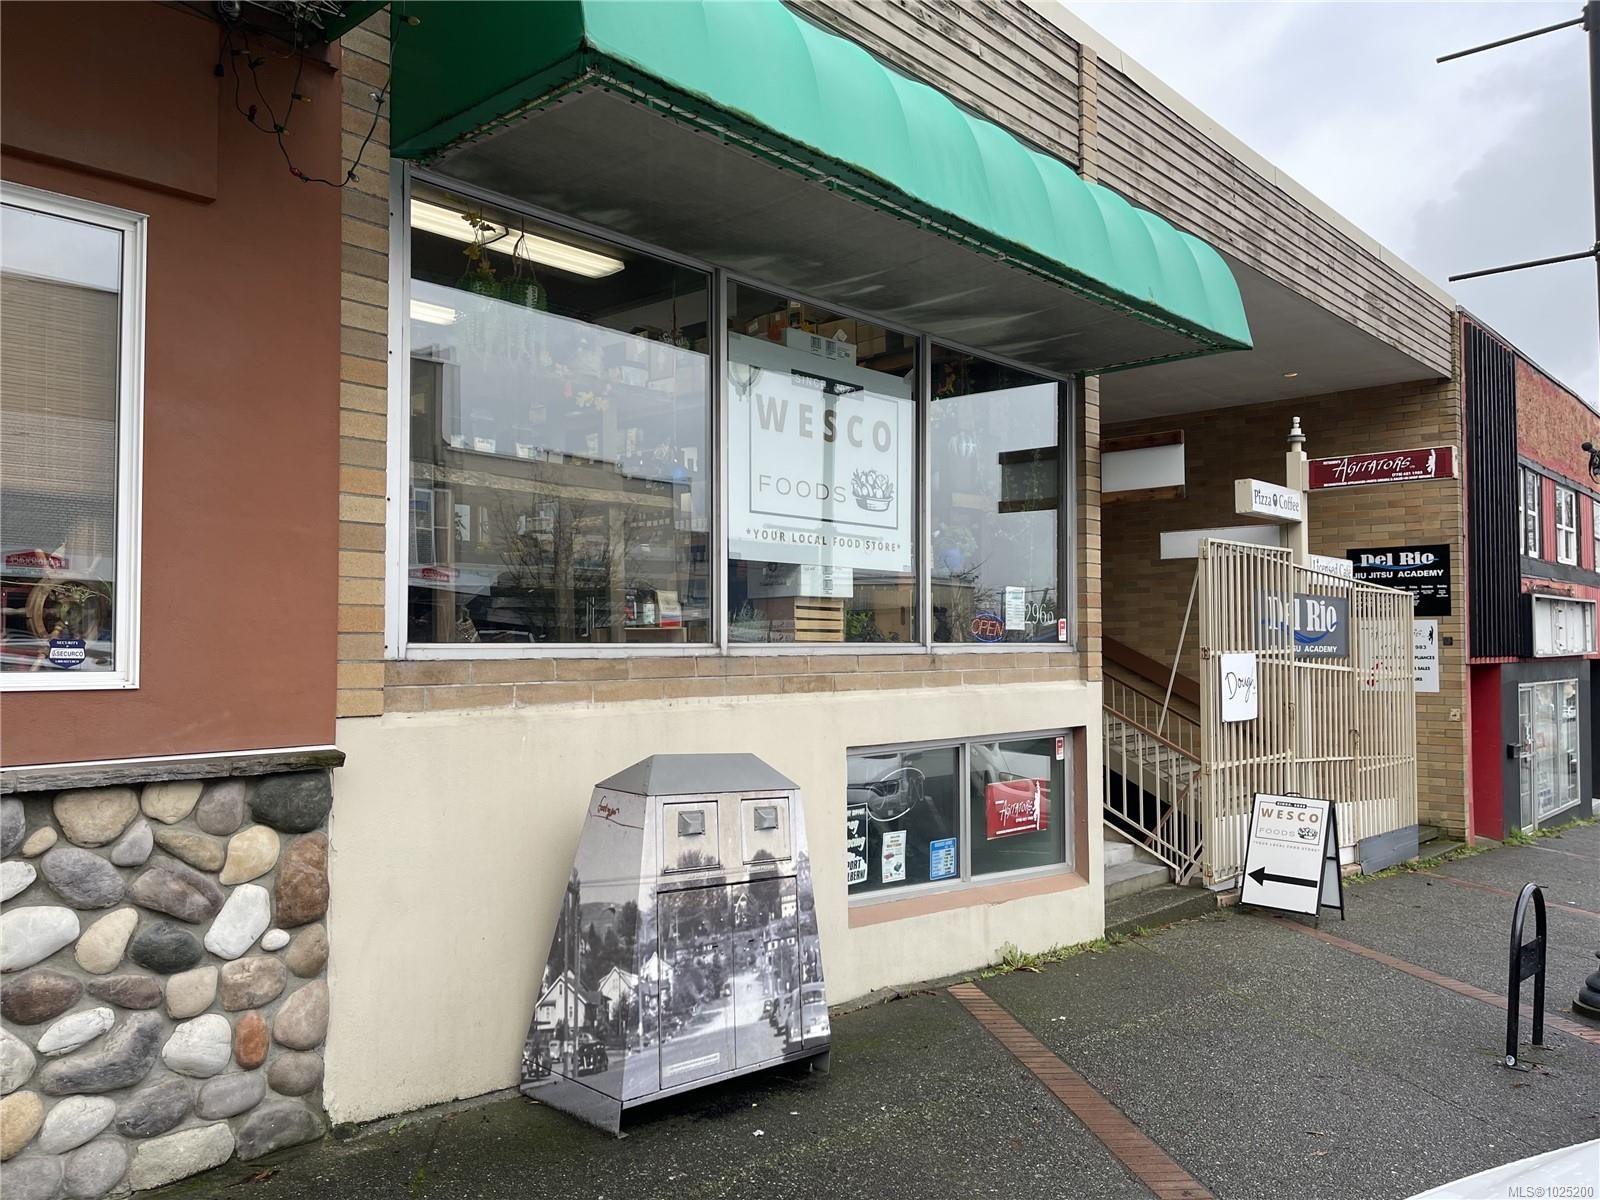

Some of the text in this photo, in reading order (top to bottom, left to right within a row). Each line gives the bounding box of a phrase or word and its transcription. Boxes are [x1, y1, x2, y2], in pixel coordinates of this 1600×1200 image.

[756, 393, 891, 453] WESCO
[1332, 456, 1411, 483] AGITATORS
[759, 474, 847, 503] FOODS
[1254, 489, 1300, 512] Pizza Coffee
[791, 533, 828, 546] LOCAL
[833, 537, 861, 549] FOOD
[1360, 551, 1435, 567] Del Rio
[1353, 569, 1444, 580] JIU JITSU ACADEMY
[1306, 599, 1337, 633] Rio
[971, 618, 1005, 637] OPEN
[1304, 645, 1338, 653] ACADEMY
[1261, 807, 1319, 824] WESCO
[1259, 827, 1296, 838] FOODS
